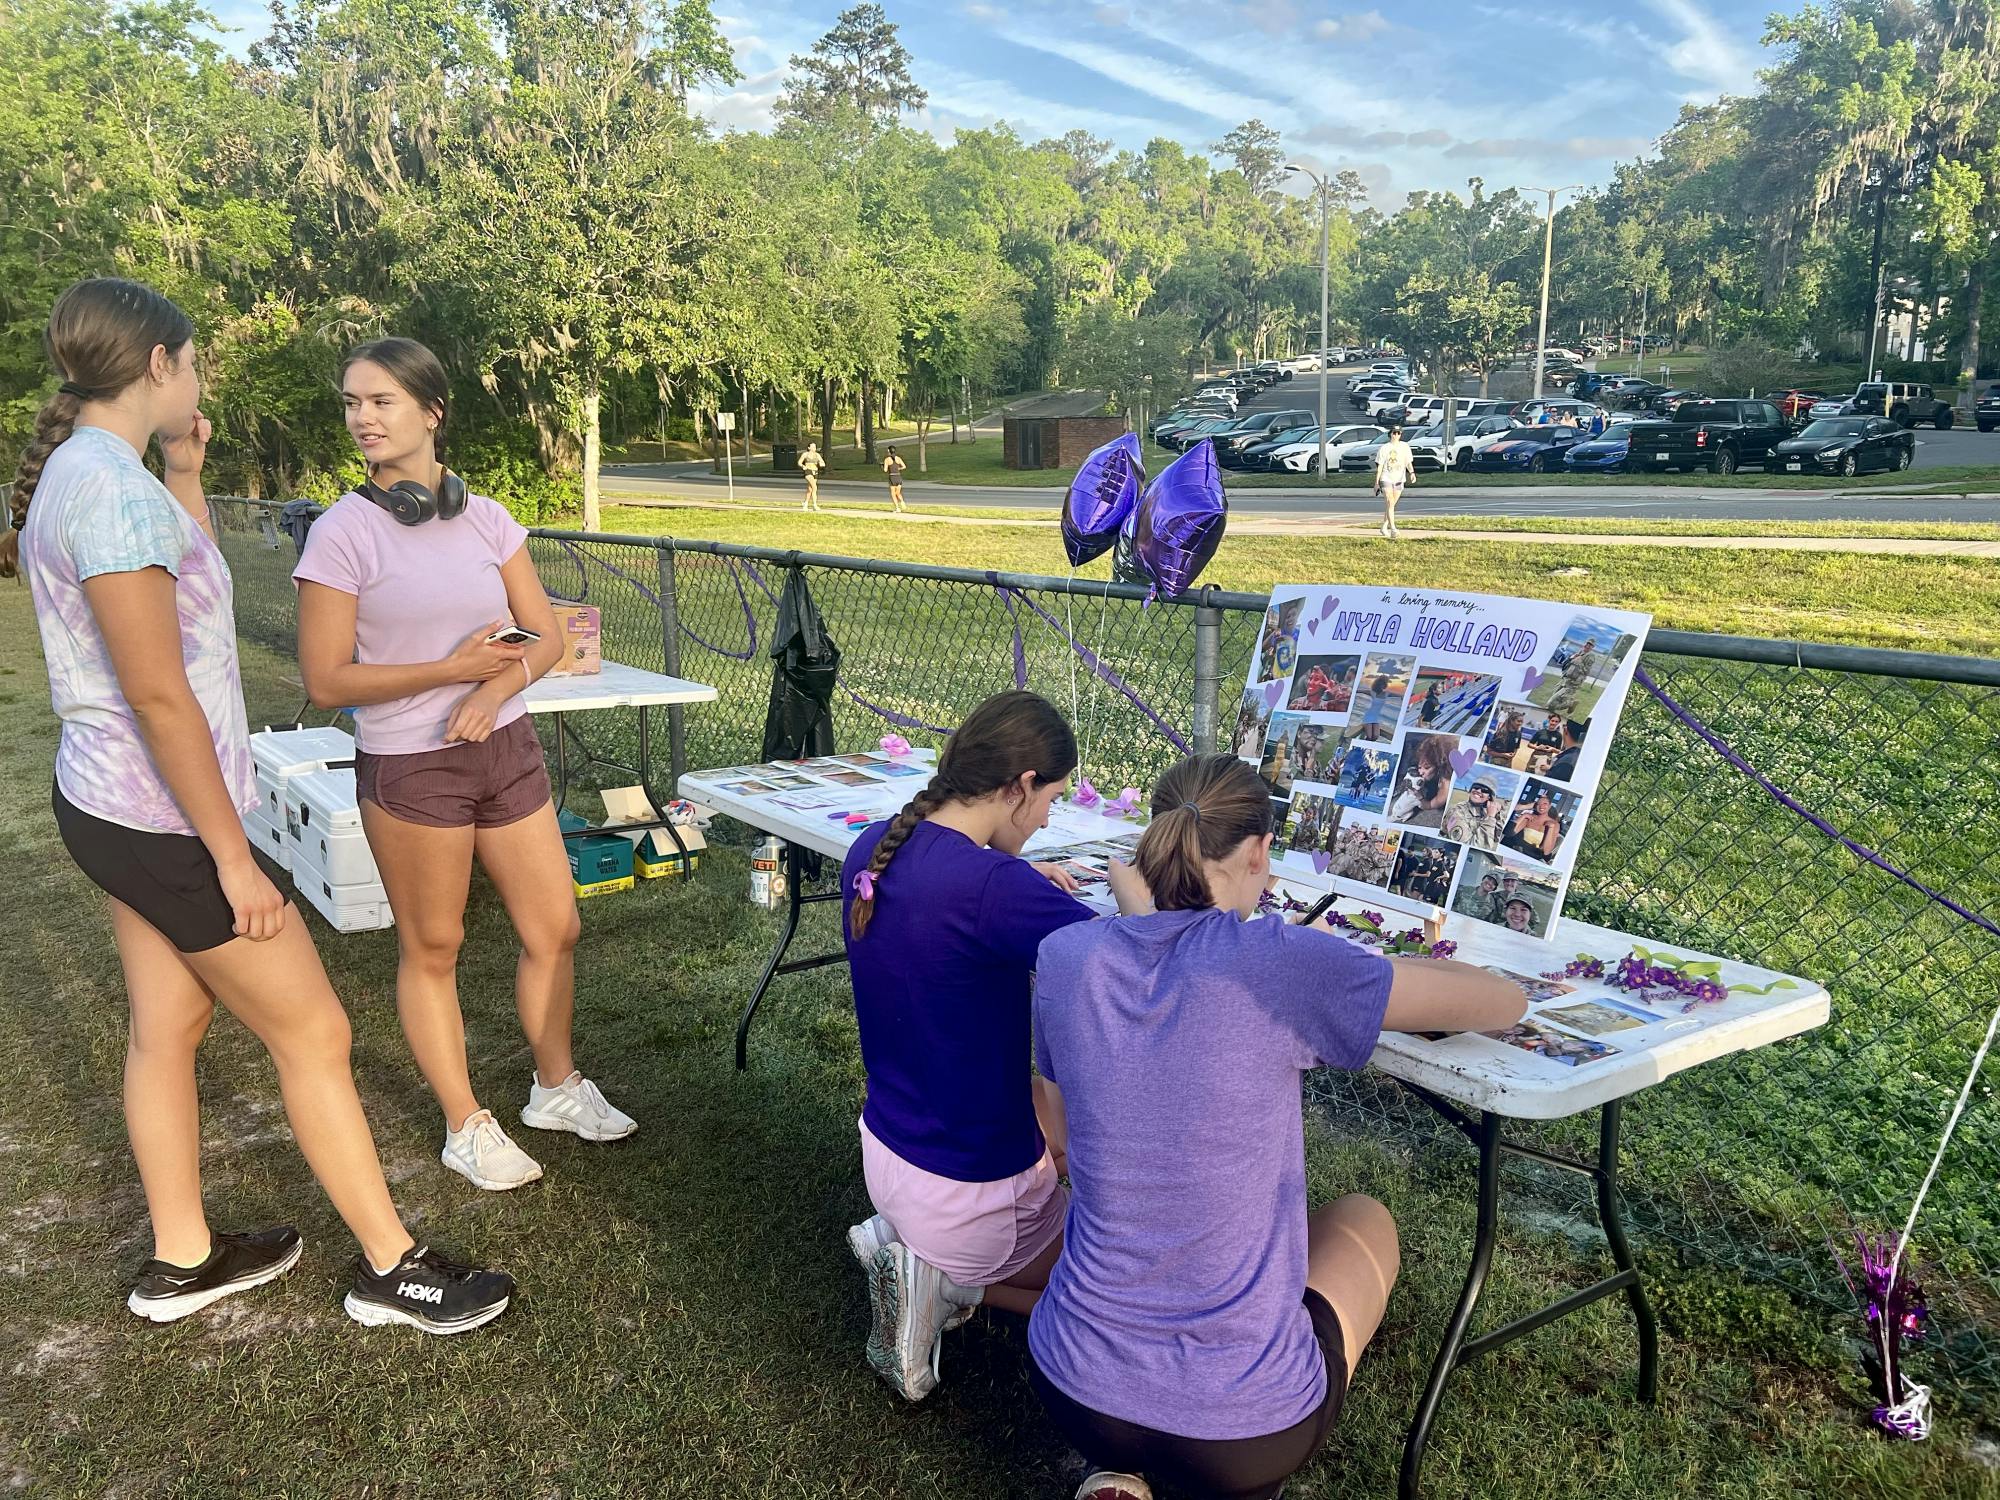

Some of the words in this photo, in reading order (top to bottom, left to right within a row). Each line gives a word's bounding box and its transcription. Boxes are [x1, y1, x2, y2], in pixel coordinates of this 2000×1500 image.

[1381, 591, 1391, 603] in
[1400, 592, 1430, 614] loving
[1332, 611, 1402, 644] NYLA
[1410, 616, 1538, 663] HOLLAND
[753, 860, 776, 870] YETI
[396, 1281, 443, 1304] HOKA
